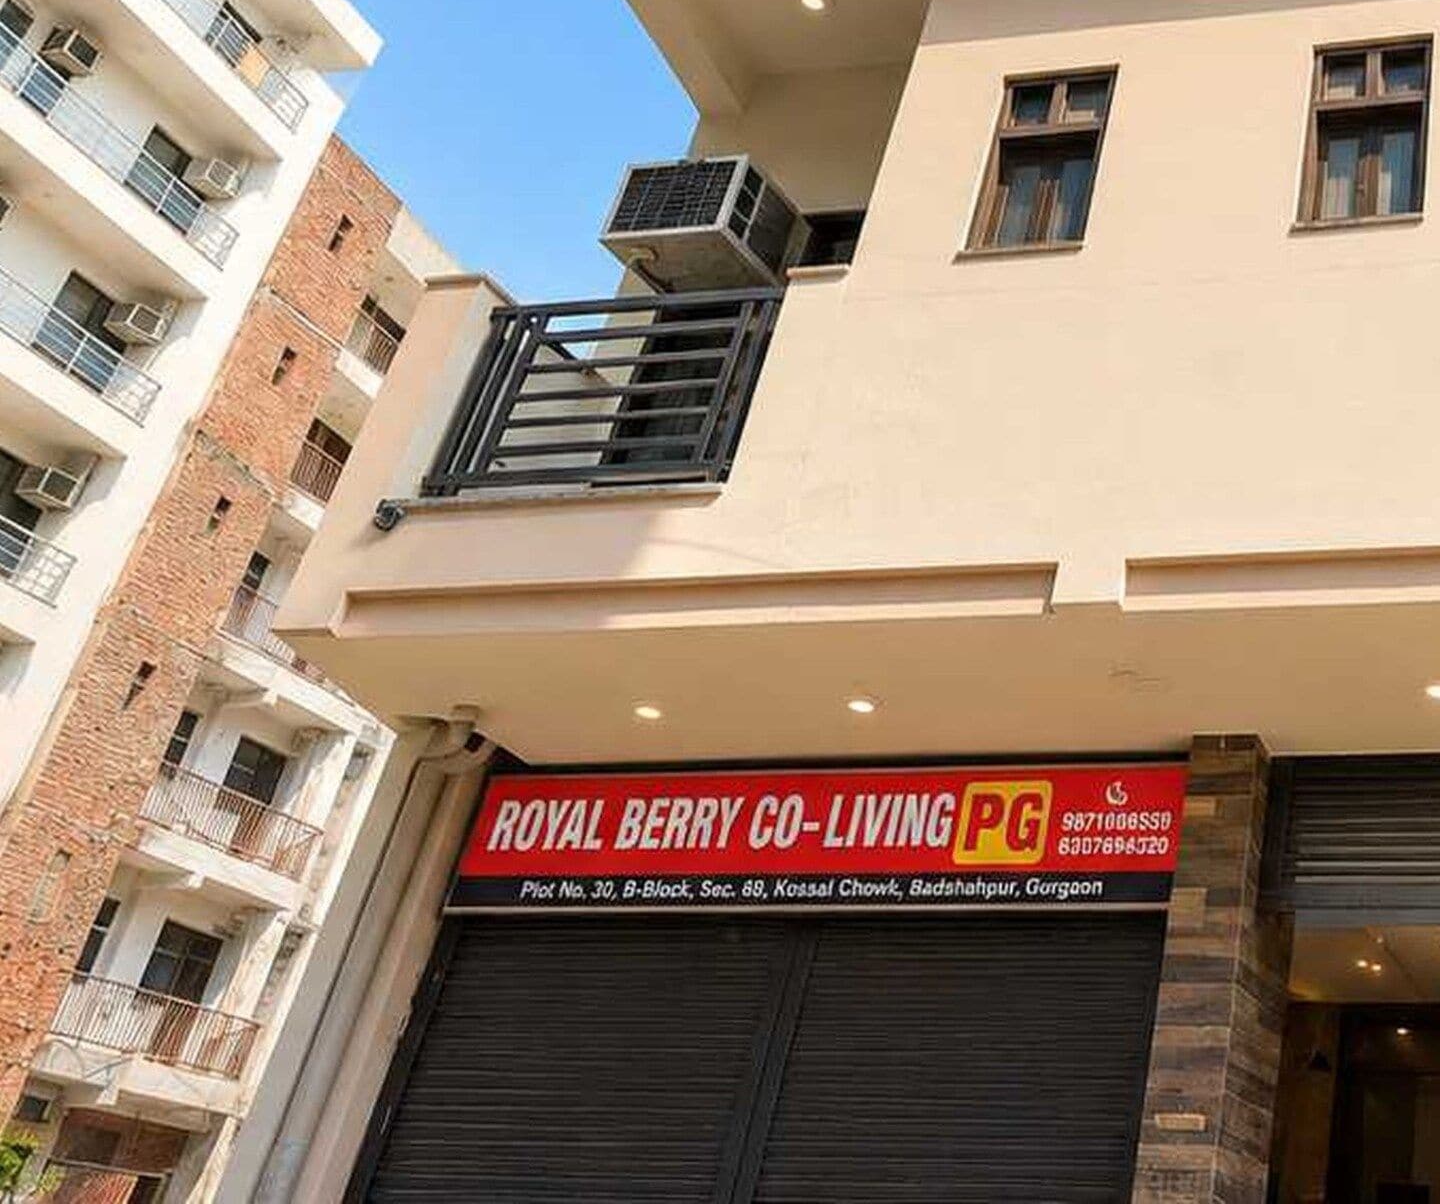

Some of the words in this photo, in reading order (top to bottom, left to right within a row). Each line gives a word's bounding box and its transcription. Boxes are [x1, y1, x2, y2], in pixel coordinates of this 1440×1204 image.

[487, 799, 605, 851] ROYAL
[614, 797, 743, 850] BERRY
[748, 793, 956, 849] CO-LIVING
[964, 793, 1044, 852] PG
[520, 880, 556, 898] Plot
[558, 880, 587, 898] No.
[590, 880, 618, 900] 30,
[622, 879, 694, 899] B-Block,
[699, 879, 736, 898] Sec.
[838, 878, 903, 901] Chowk,
[909, 877, 1021, 901] Badshahpur,
